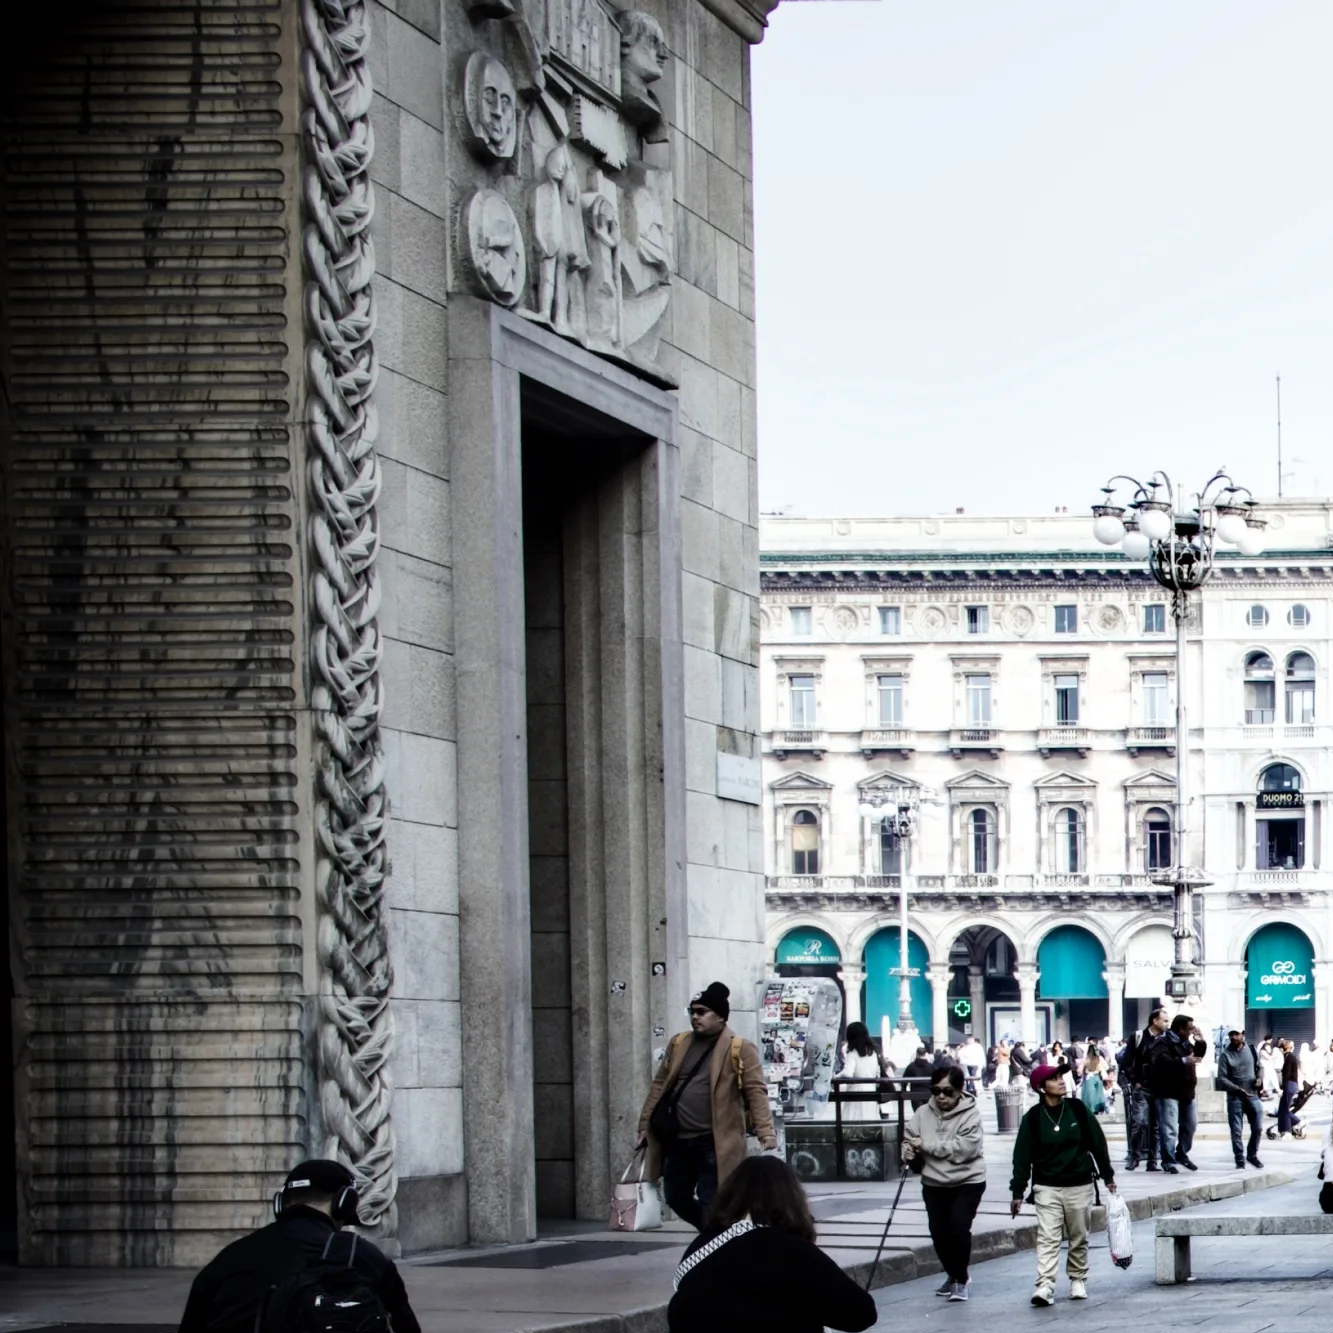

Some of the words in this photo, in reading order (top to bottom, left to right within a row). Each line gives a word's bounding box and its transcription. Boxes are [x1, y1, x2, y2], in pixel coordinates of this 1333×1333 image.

[1262, 794, 1293, 802] DUOMO
[1294, 793, 1303, 802] 21
[803, 939, 822, 955] R
